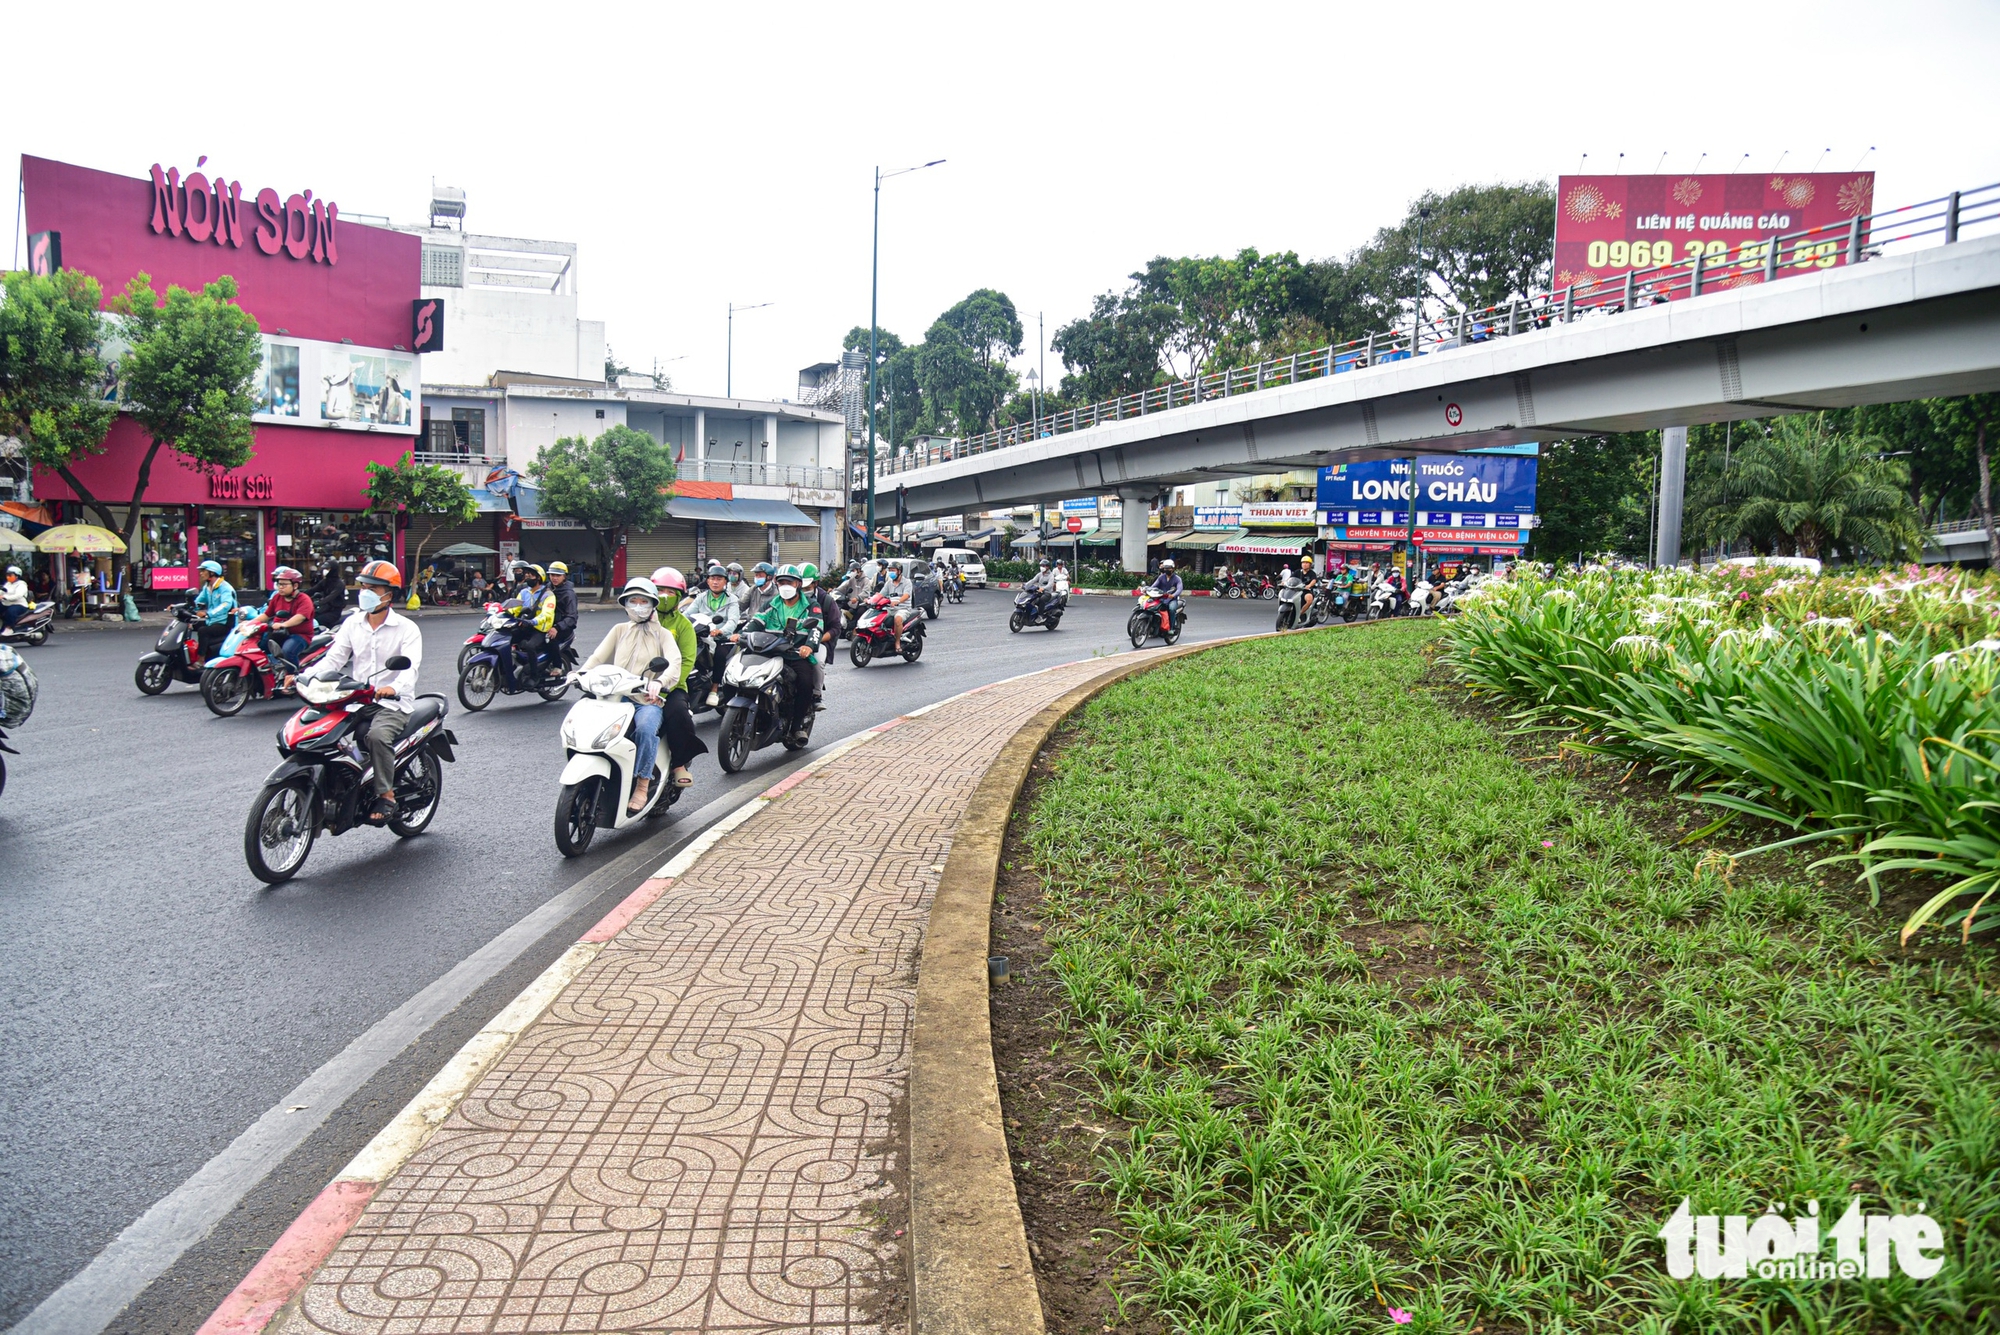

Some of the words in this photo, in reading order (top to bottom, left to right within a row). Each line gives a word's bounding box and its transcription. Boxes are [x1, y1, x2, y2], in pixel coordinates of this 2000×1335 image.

[149, 156, 244, 248] NÓN
[255, 188, 338, 265] SƠN
[1636, 214, 1672, 230] LIÊN
[1675, 214, 1695, 232] HỆ
[1700, 212, 1753, 230] QUẢNG
[1758, 214, 1790, 230] CÁO
[1422, 460, 1464, 476] THUỐC
[1352, 480, 1420, 501] LONG
[1428, 477, 1498, 502] CHÂU
[1220, 515, 1238, 525] ANH
[1349, 528, 1379, 537] CHUYÊN
[1456, 531, 1476, 540] BỆNH
[1478, 532, 1496, 540] VIỆN
